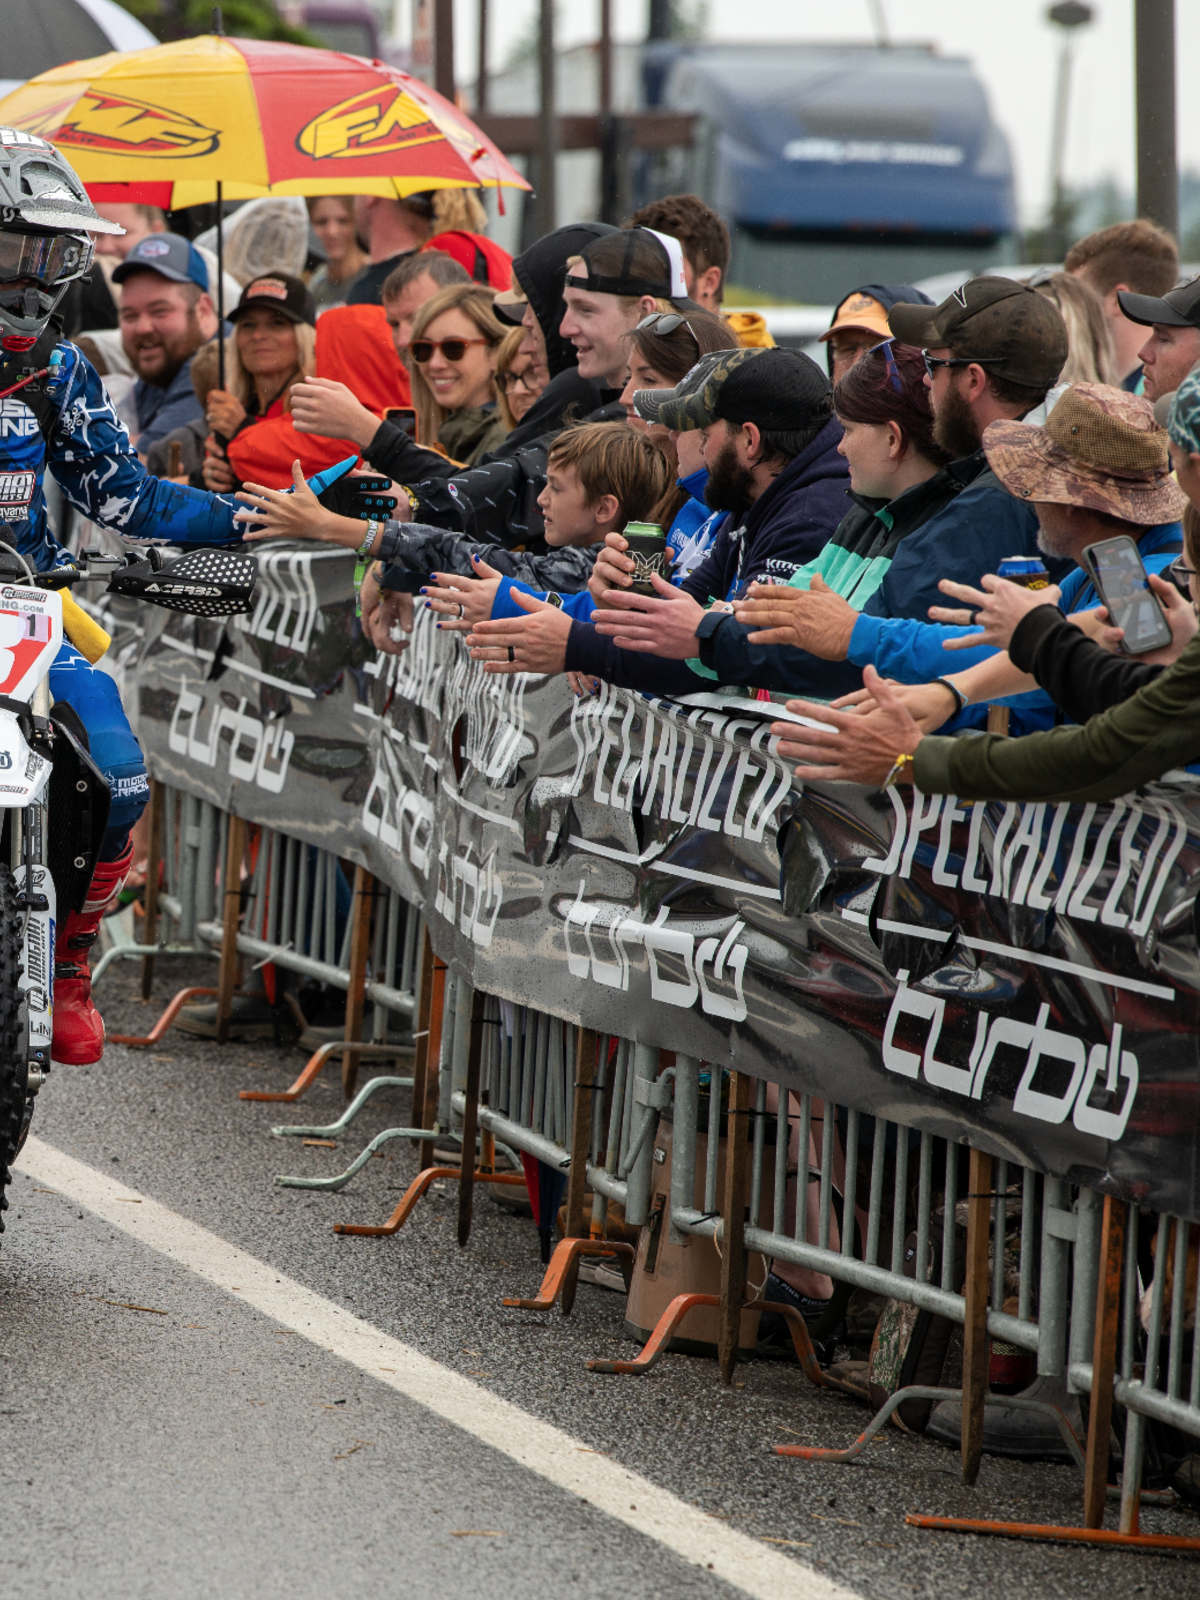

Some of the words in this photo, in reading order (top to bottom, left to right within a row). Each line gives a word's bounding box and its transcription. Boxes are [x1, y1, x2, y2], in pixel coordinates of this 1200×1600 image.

[144, 583, 222, 597] ACERBIS
[26, 613, 36, 637] 1
[881, 968, 1140, 1142] turbo
